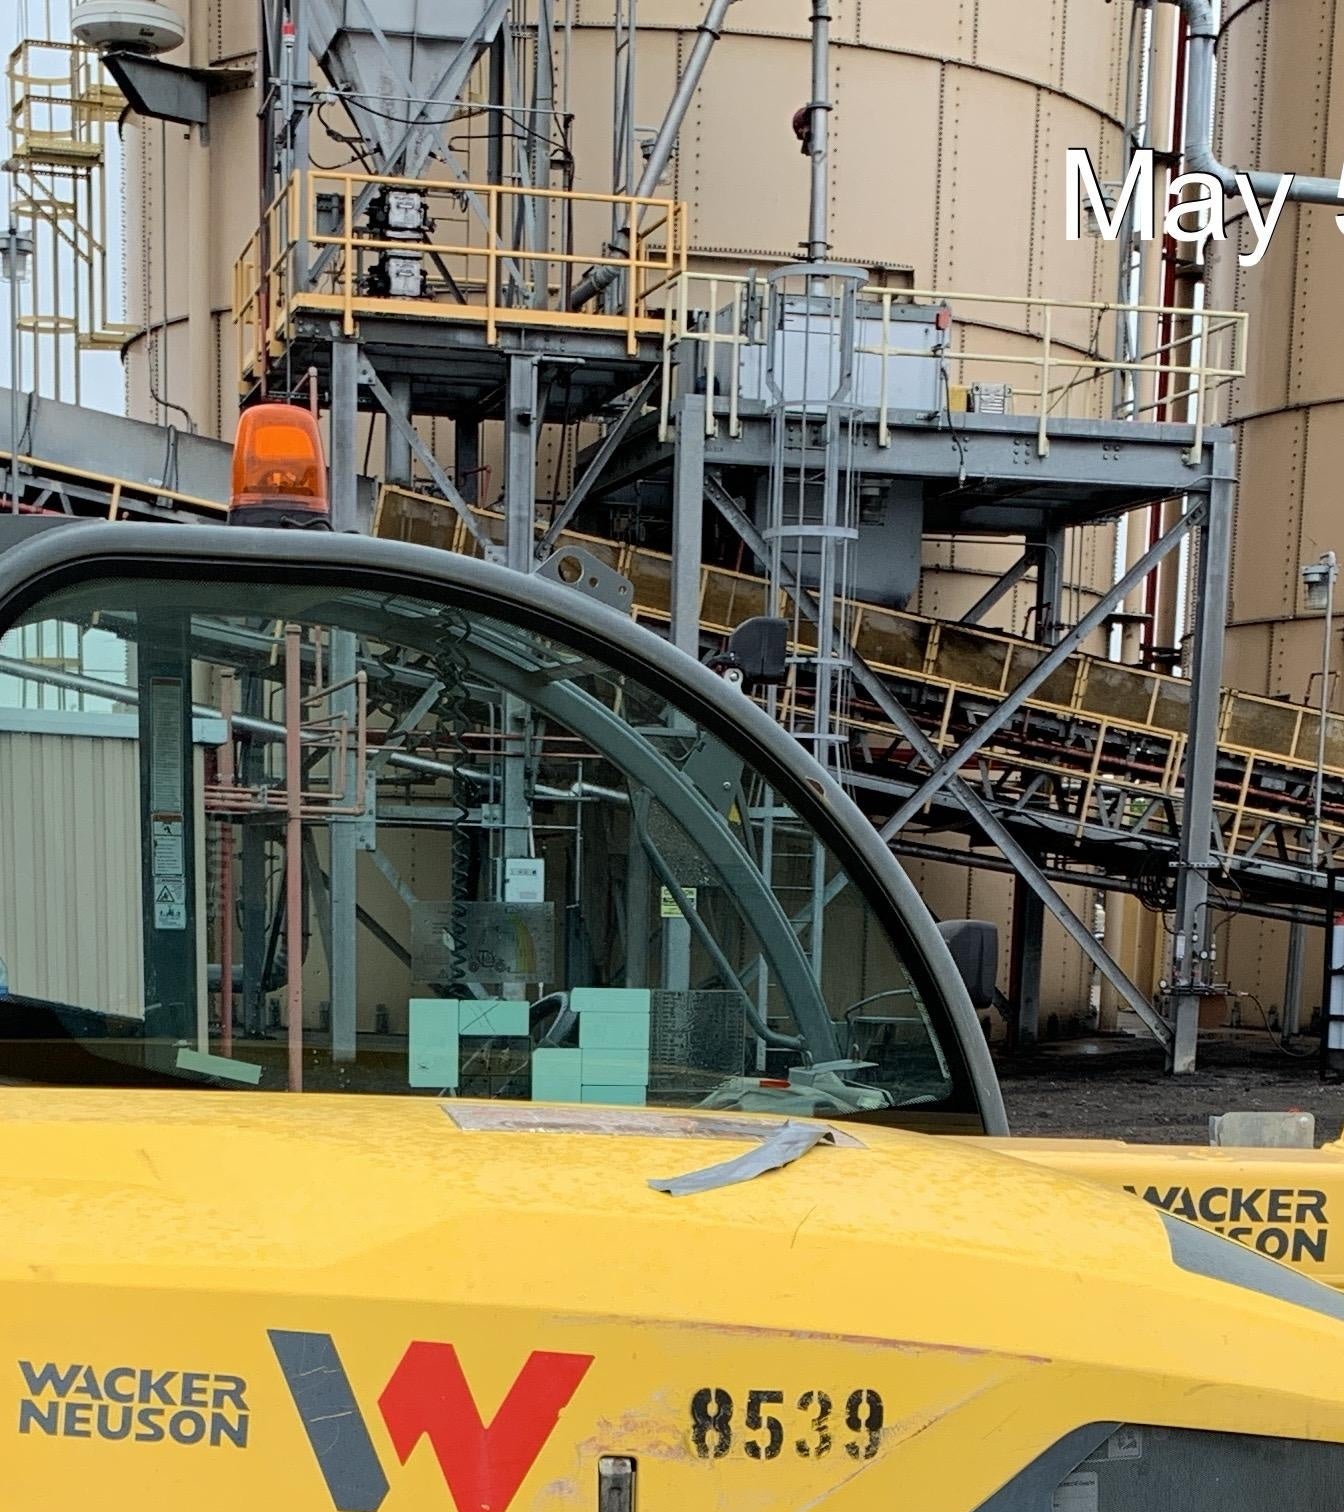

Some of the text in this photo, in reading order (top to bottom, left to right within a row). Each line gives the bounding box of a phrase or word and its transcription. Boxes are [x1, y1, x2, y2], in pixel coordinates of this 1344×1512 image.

[18, 1360, 250, 1411] WACKER
[18, 1399, 250, 1449] NEUSON
[690, 1387, 884, 1460] 8539
